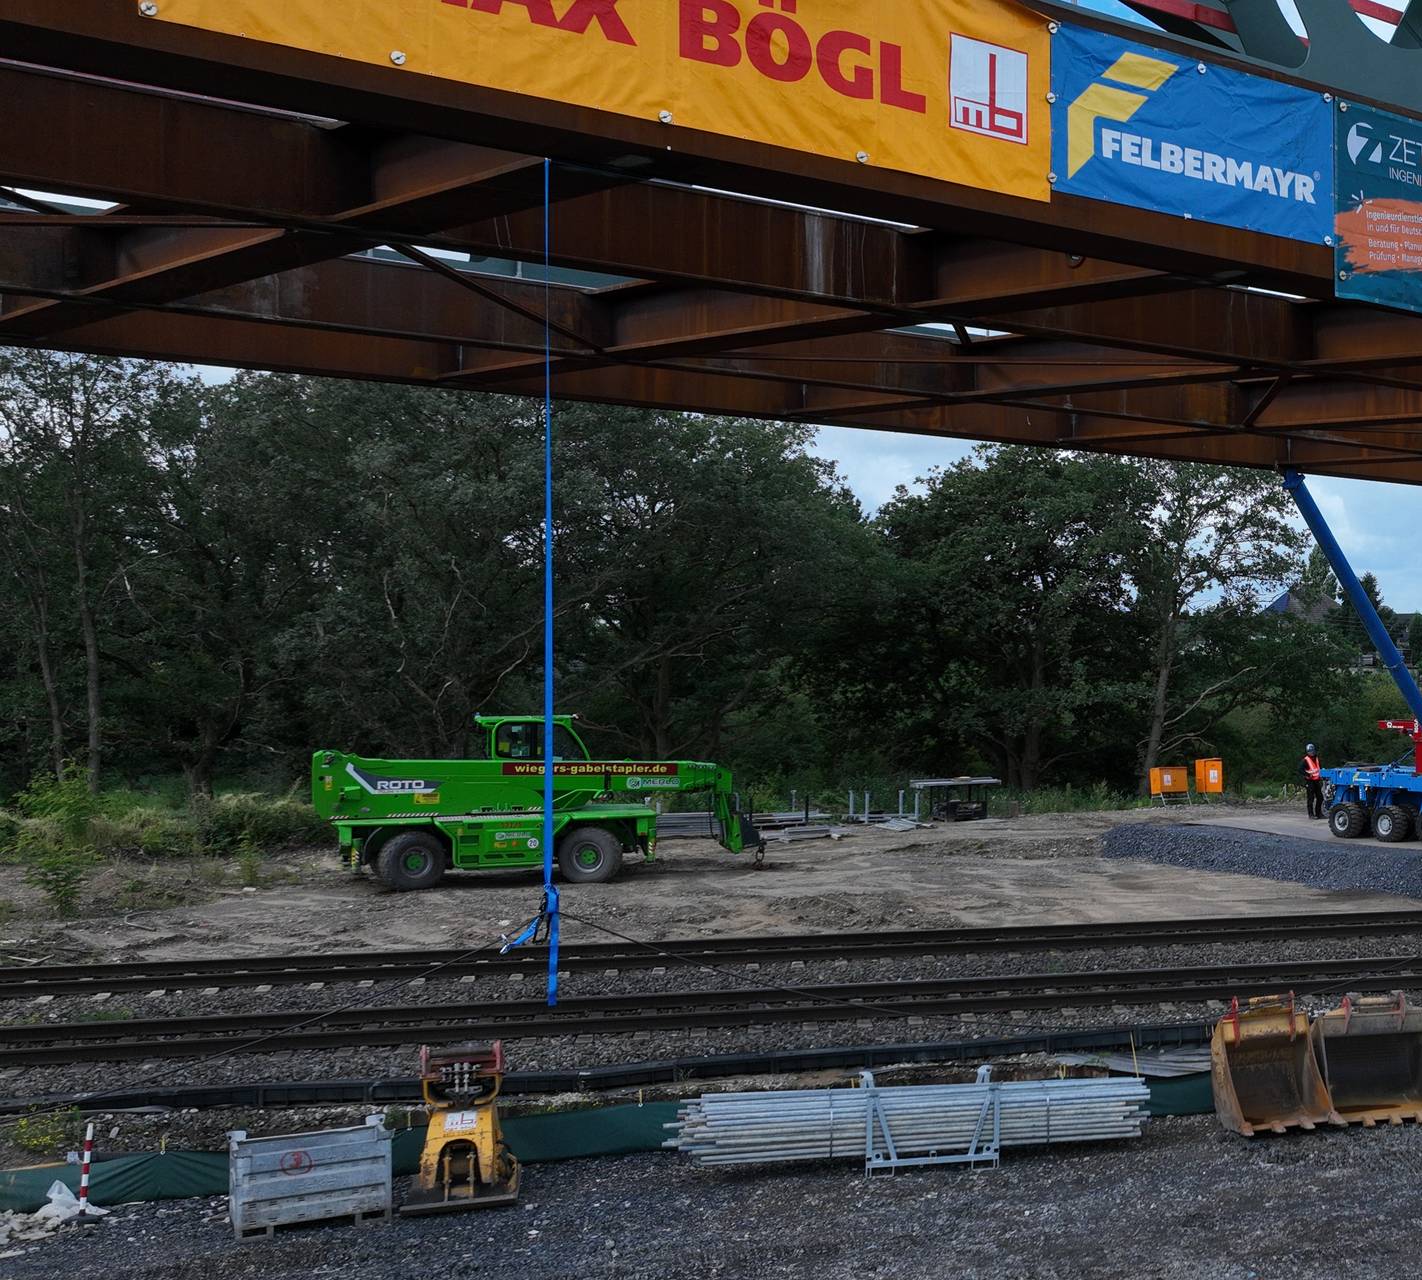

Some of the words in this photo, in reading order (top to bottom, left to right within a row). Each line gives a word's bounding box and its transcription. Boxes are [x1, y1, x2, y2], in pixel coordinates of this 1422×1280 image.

[679, 0, 926, 114] BÖGL
[1376, 224, 1388, 232] und
[1390, 224, 1400, 233] für
[1368, 238, 1398, 251] Beratung
[1369, 251, 1396, 263] Prüfung
[515, 763, 668, 774] wiegrs-gabelstapler.de
[376, 780, 425, 790] ROTO
[528, 839, 538, 848] 20
